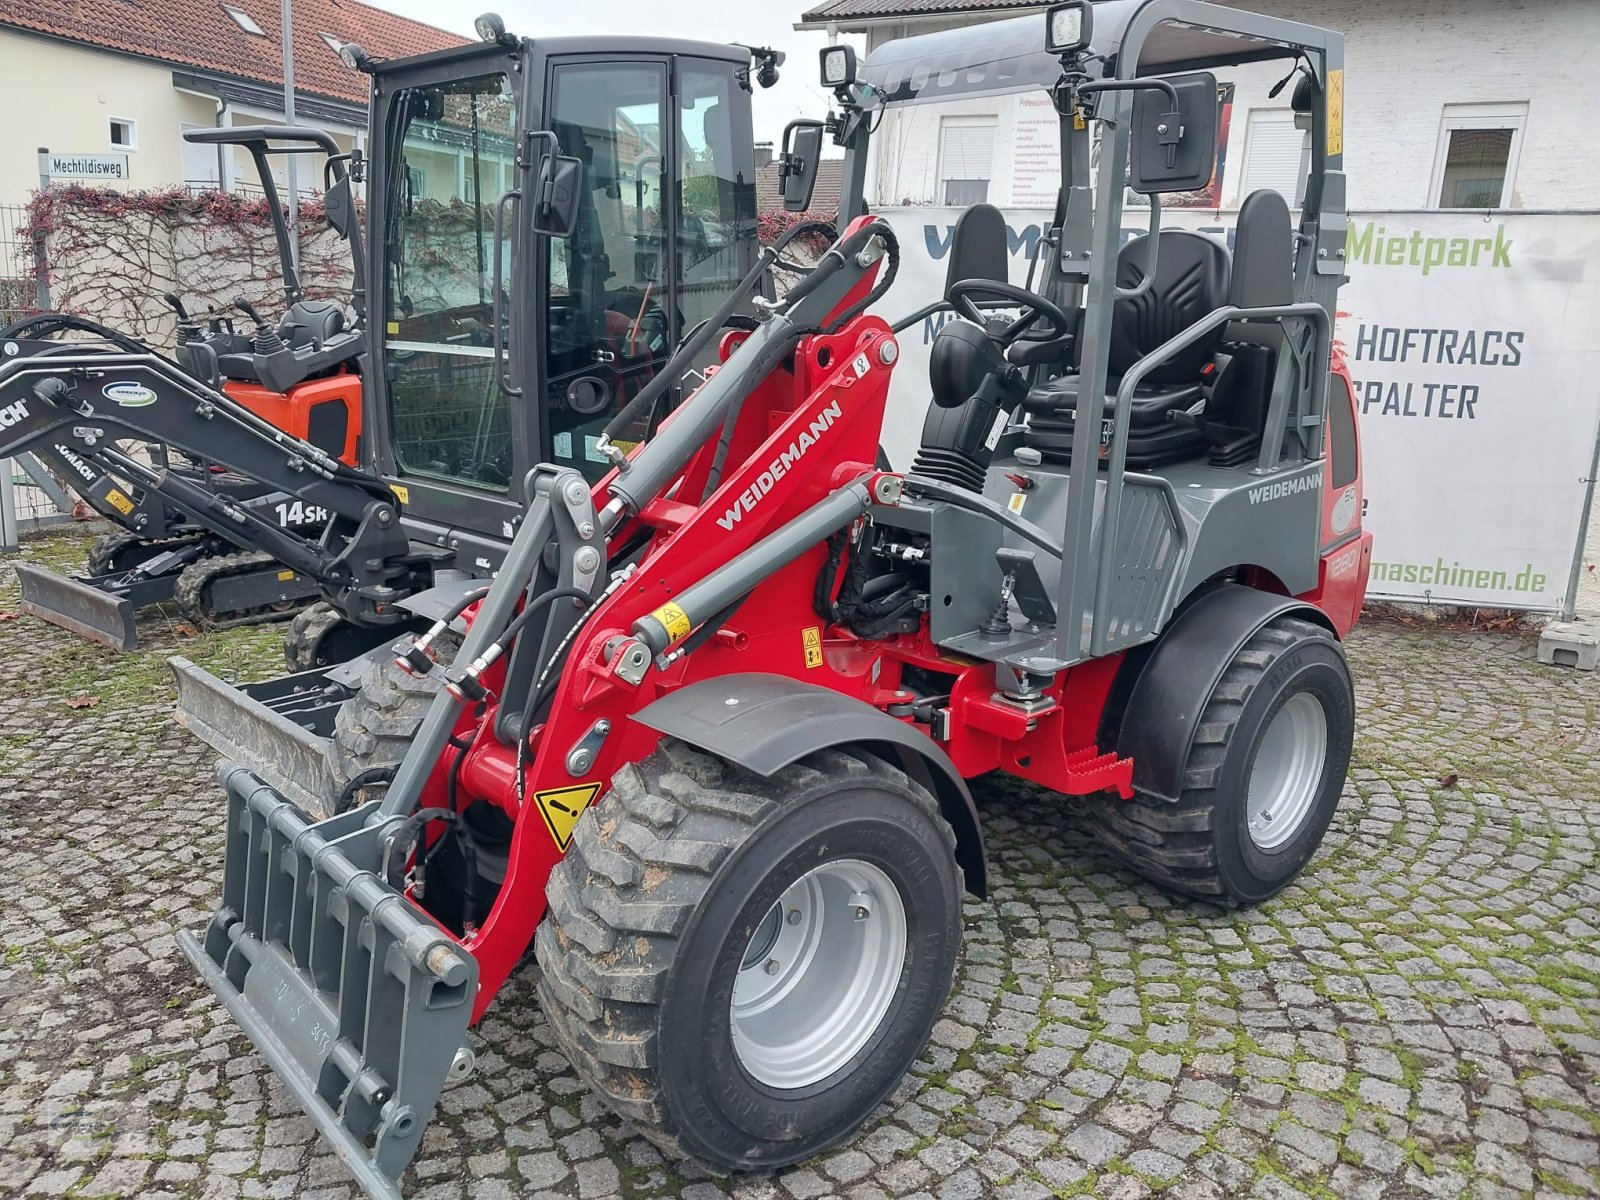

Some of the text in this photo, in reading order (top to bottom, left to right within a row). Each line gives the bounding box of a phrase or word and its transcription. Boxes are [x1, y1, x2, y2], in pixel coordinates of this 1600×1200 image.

[53, 158, 122, 178] Mechtildisweg
[1345, 222, 1513, 276] Mietpark
[1355, 324, 1525, 367] HOFTRACS
[716, 399, 843, 531] WEIDEMANN
[1248, 472, 1323, 505] WEIDEMANN
